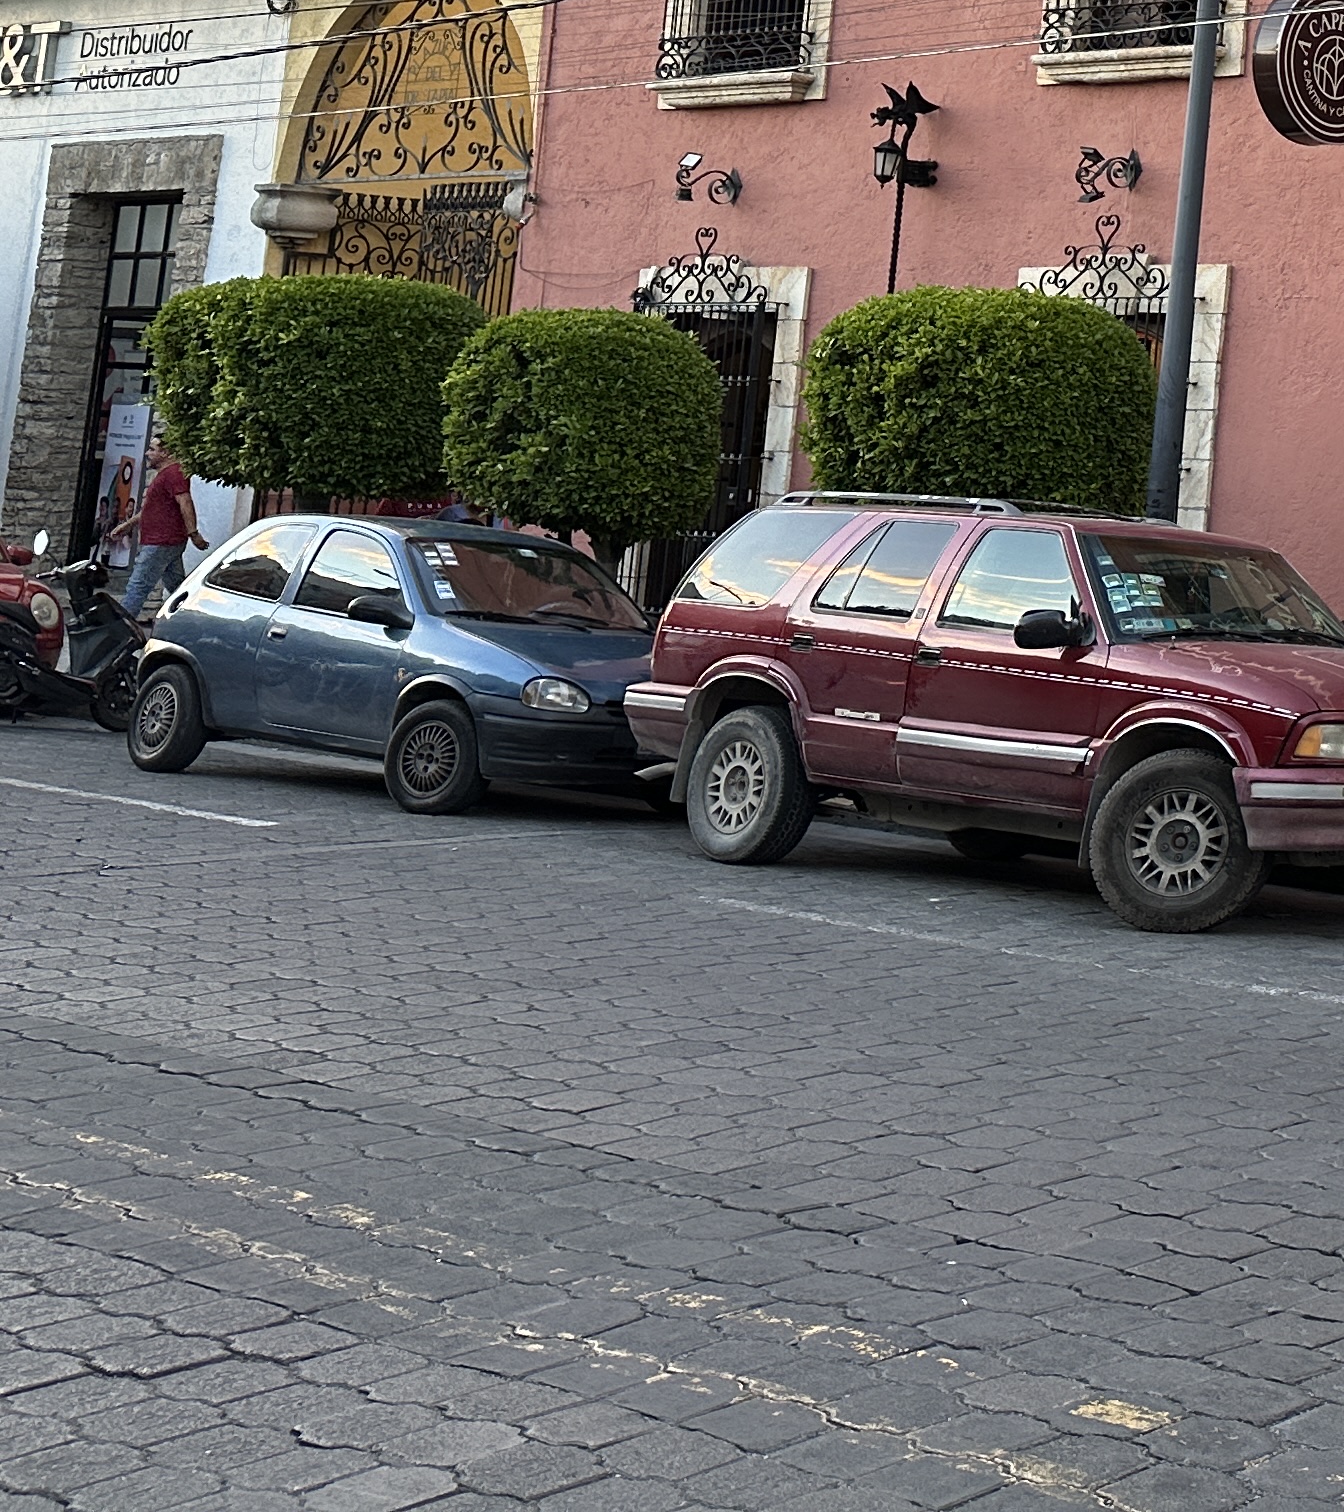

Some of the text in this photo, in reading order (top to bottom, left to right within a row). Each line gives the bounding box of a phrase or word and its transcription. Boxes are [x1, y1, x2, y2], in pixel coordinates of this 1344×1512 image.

[0, 20, 64, 96] &T
[80, 24, 194, 59] Distribuidor
[1298, 39, 1312, 56] A
[1304, 70, 1328, 115] CANTINA
[1329, 106, 1337, 117] Y
